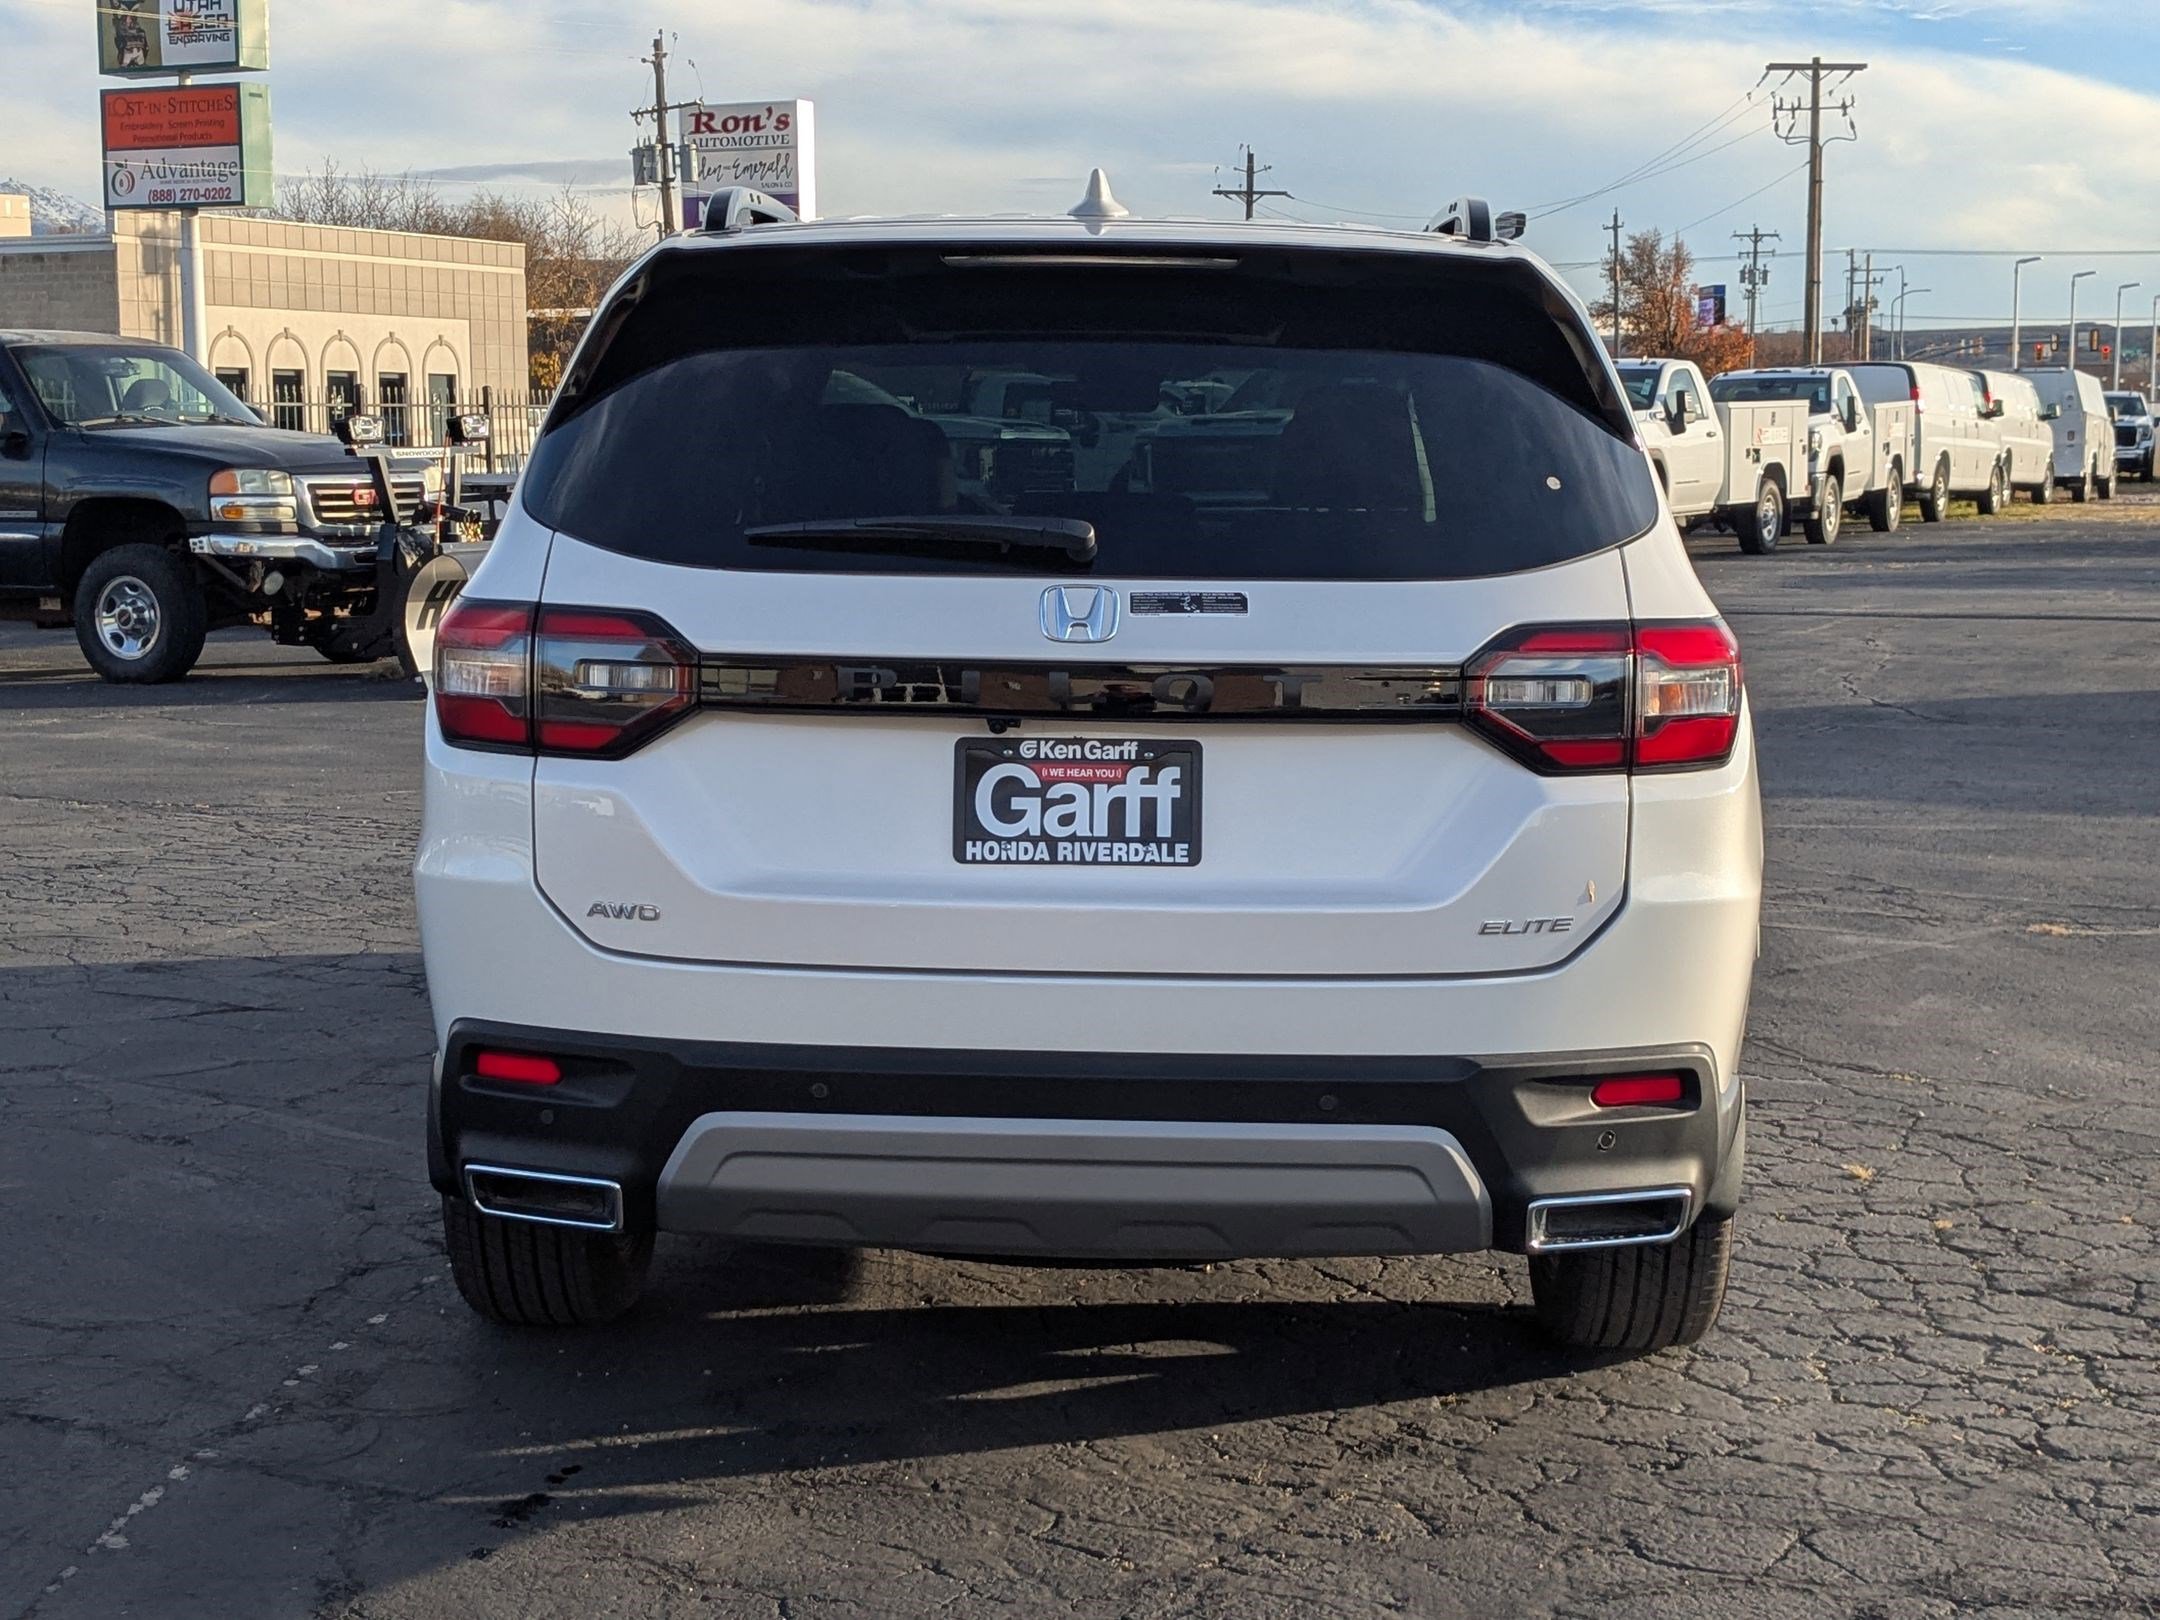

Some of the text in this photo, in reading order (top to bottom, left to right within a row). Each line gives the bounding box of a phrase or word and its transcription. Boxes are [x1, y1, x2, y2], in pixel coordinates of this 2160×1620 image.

[688, 106, 791, 135] Ron's
[140, 158, 238, 182] Advantage
[731, 152, 793, 181] Emerald
[148, 187, 232, 204] (888) 270-0202
[1040, 741, 1082, 759] Ken
[1084, 741, 1139, 760] Garff
[1049, 768, 1116, 778] WE HEAR YOU
[975, 763, 1181, 838] Garff
[966, 841, 1189, 863] HONDA RIVERDALE
[586, 902, 661, 921] AWD
[1478, 916, 1574, 935] ELITE
